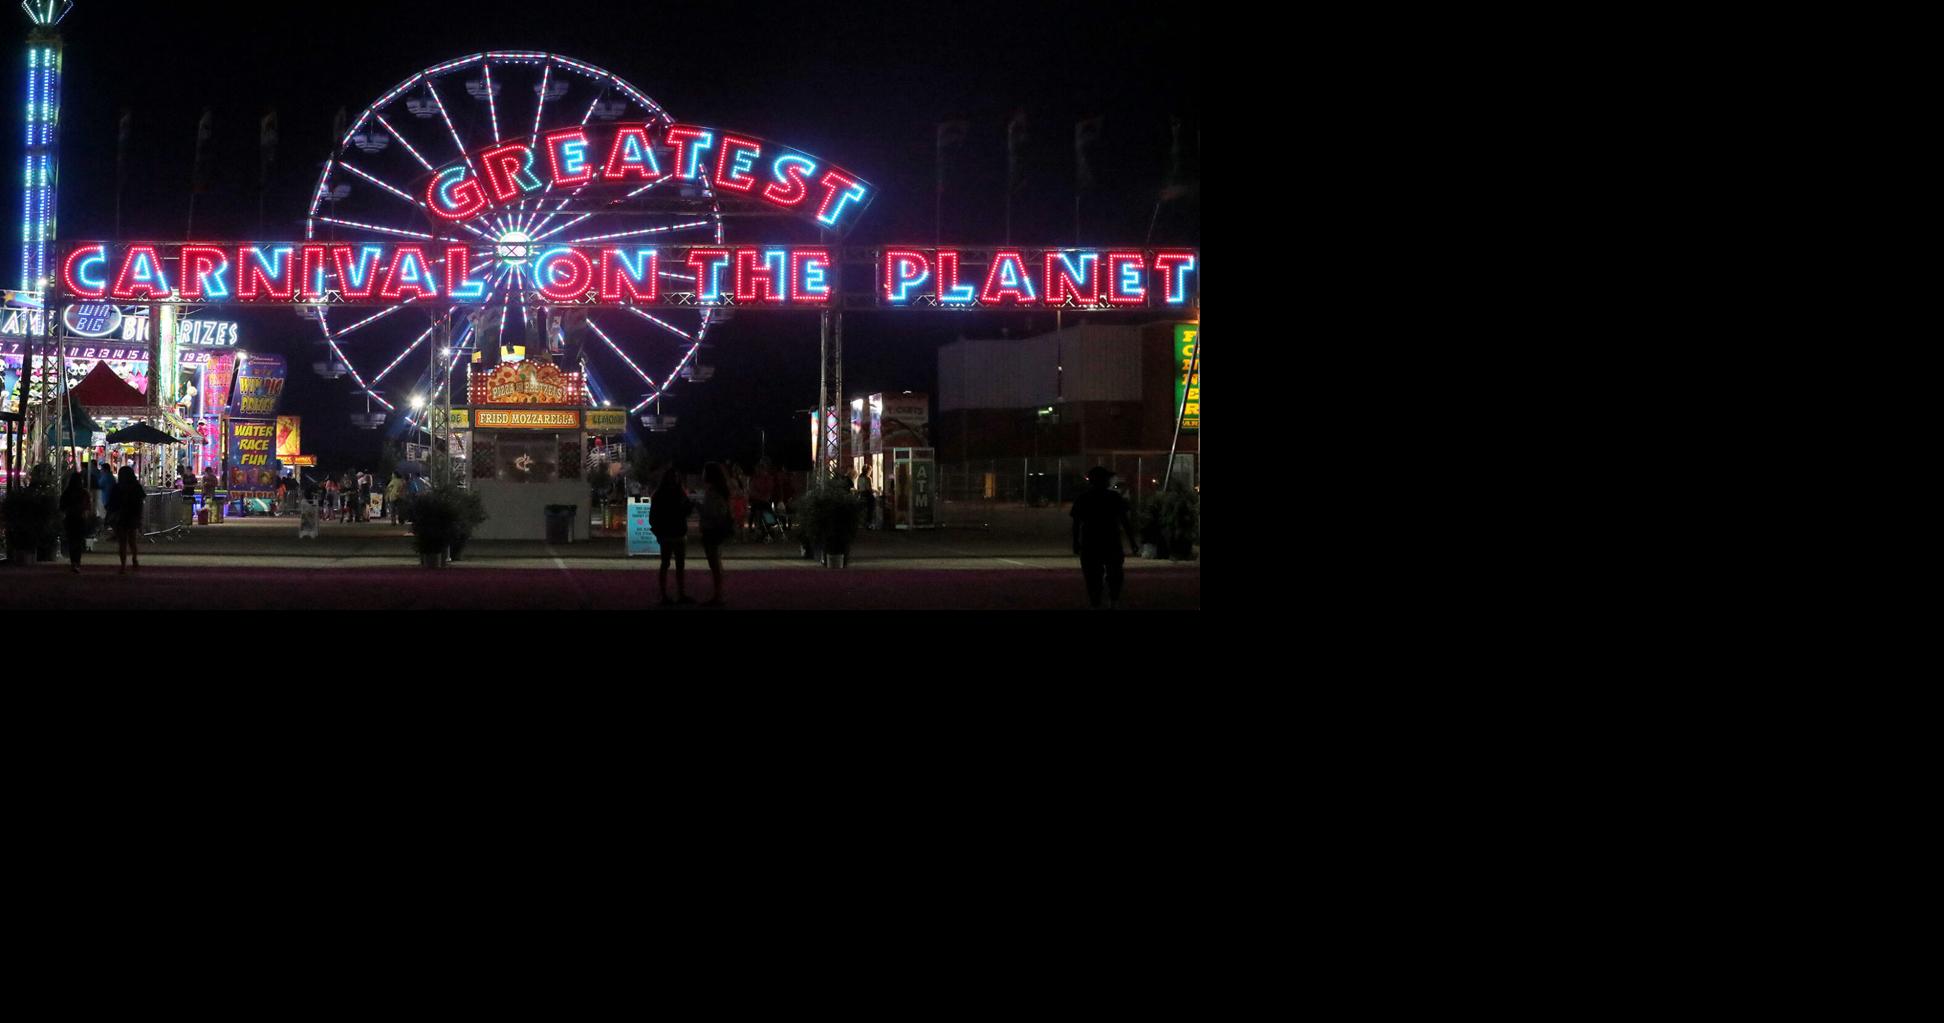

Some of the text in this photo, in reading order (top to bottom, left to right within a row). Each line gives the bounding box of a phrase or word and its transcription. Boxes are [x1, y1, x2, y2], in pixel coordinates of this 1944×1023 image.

[426, 125, 866, 226] GREATEST
[64, 245, 1195, 304] CARNIVAL ON THE PLANET
[76, 318, 104, 331] BIG
[122, 317, 238, 345] BI RIZES
[84, 348, 95, 358] 12
[98, 349, 110, 359] 13
[113, 349, 124, 359] 14
[127, 350, 139, 360] 15
[480, 413, 576, 425] FRIED MOZZARELLA
[234, 425, 273, 437] WATER
[239, 439, 269, 450] RACE
[241, 454, 267, 465] FUN
[915, 465, 928, 507] ATM
